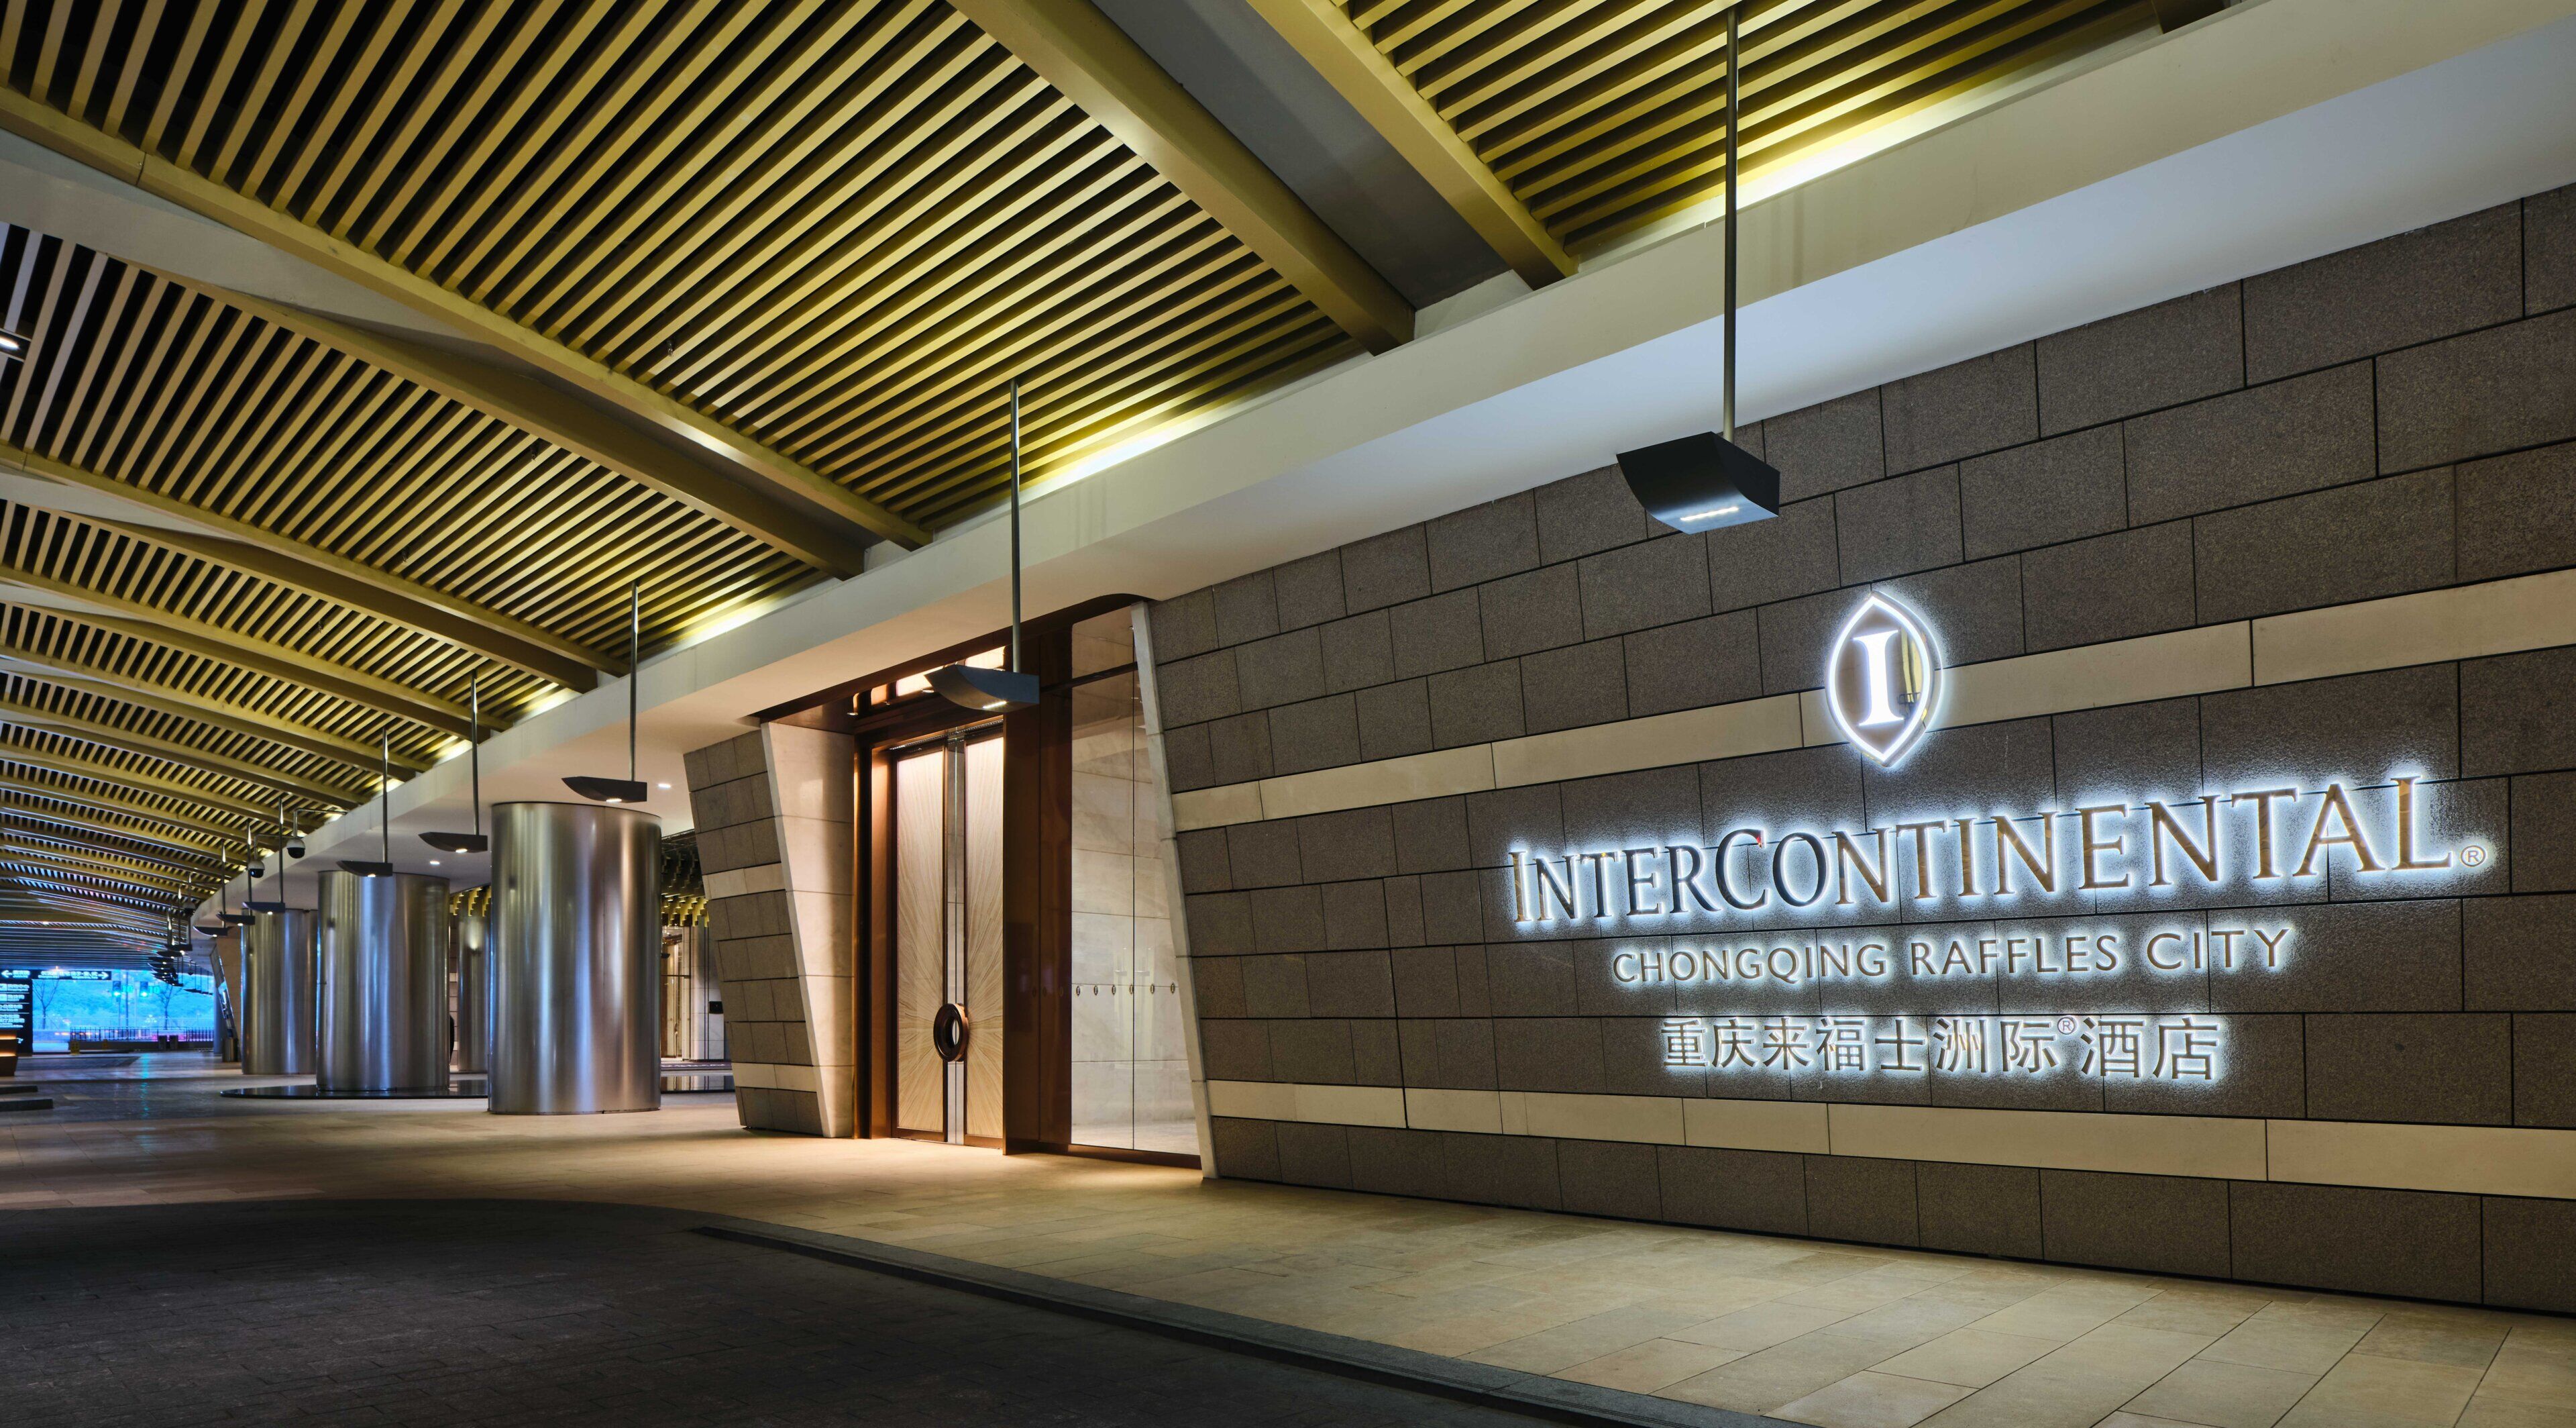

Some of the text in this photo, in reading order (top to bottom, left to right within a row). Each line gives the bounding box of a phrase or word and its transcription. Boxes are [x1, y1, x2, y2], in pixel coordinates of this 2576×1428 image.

[1613, 928, 2290, 984] CHONGQING RAFFLES CITY
